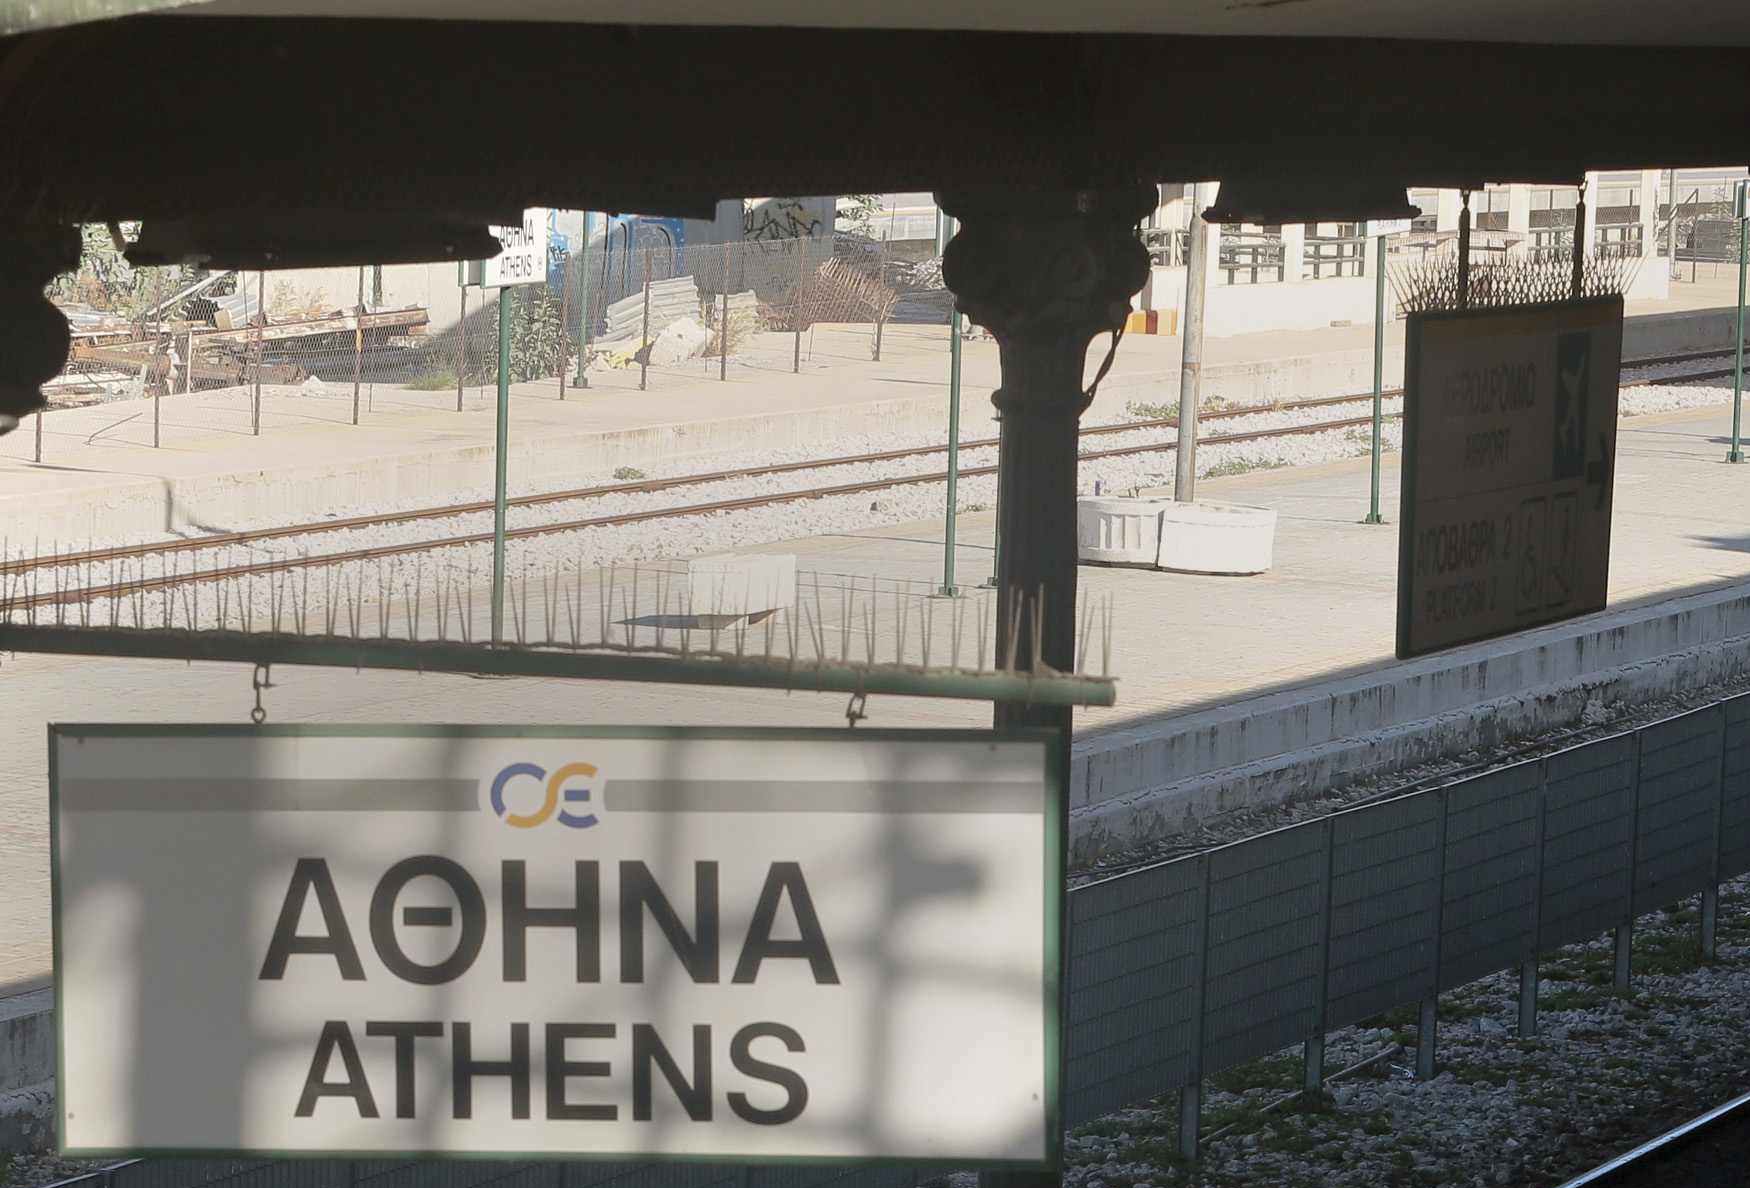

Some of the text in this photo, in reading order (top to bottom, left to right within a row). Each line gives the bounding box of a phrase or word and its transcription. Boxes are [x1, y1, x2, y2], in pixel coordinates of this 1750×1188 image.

[499, 219, 534, 249] ΑΘΗΝΑ
[499, 254, 533, 280] ATHENS
[1464, 425, 1511, 471] AIRPORT
[1502, 511, 1512, 556] 2
[258, 853, 840, 987] ΑΘΗΝΑ
[294, 1019, 809, 1126] ATHENS
